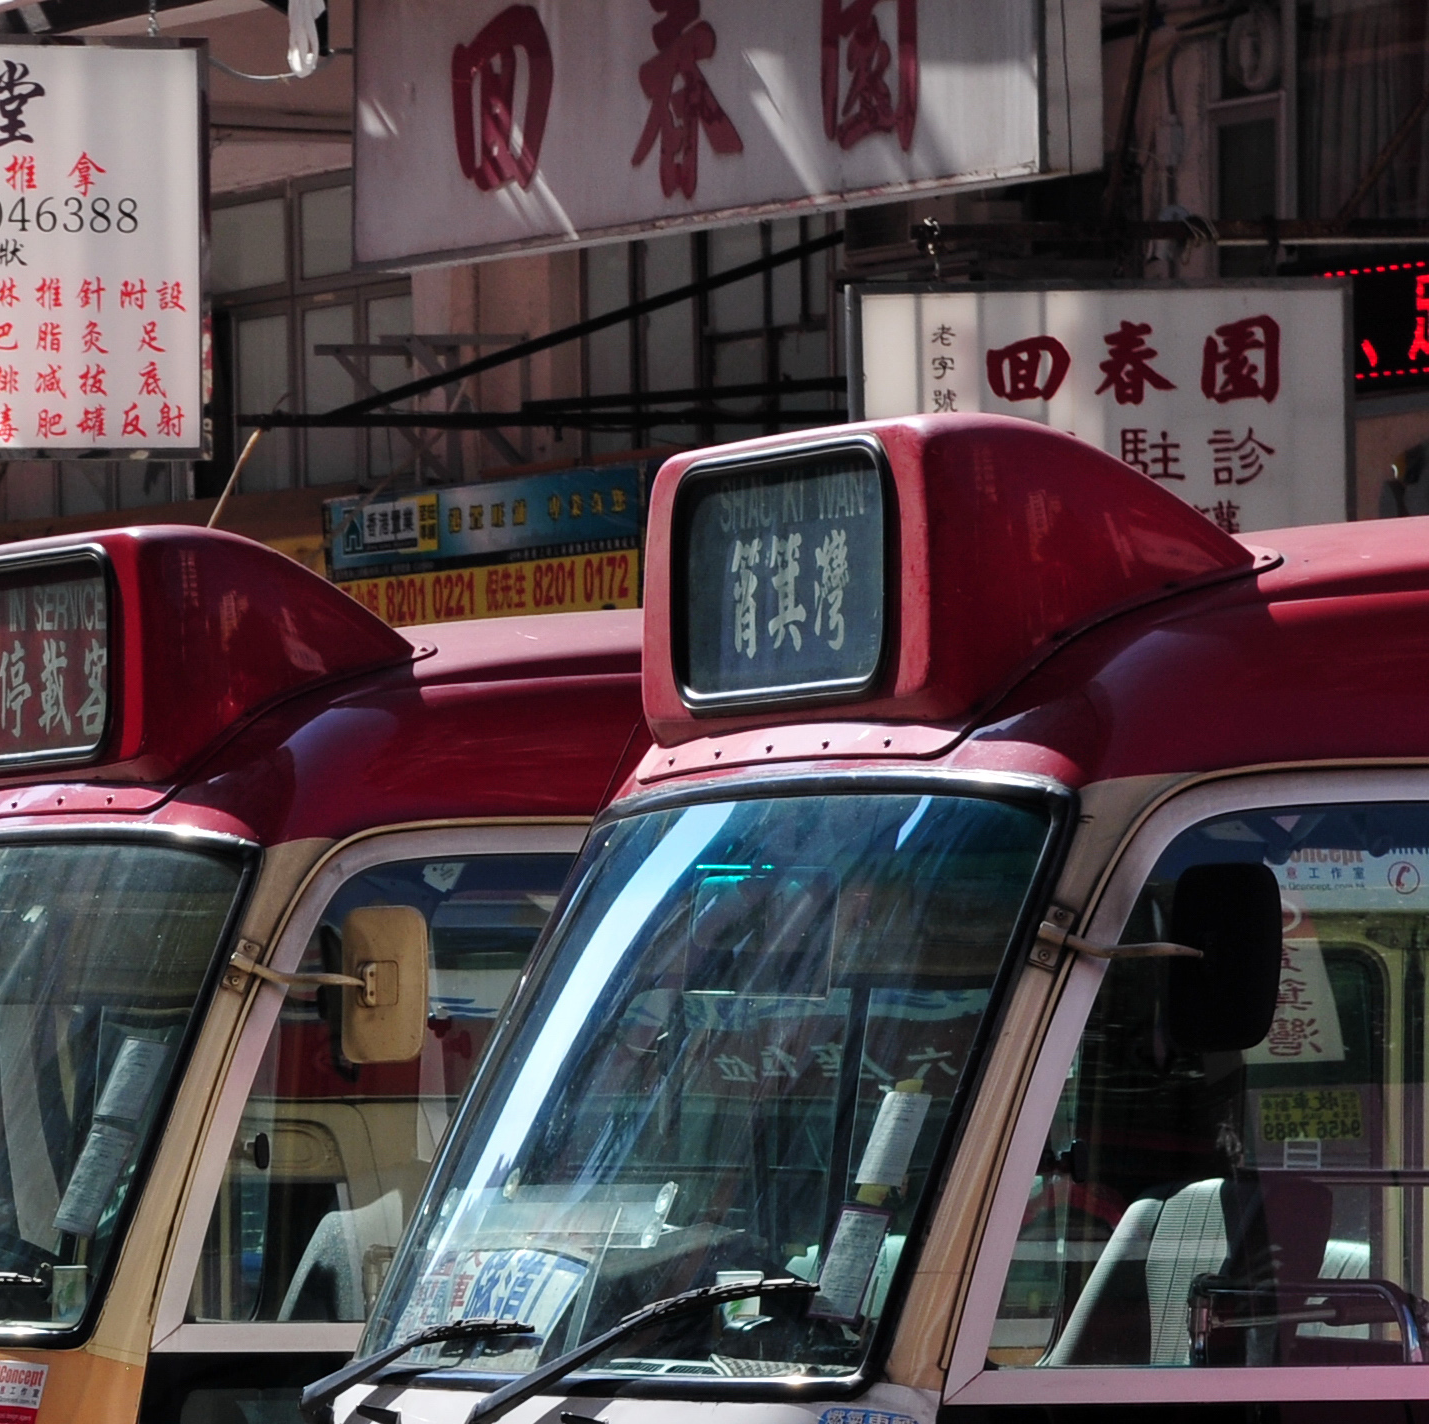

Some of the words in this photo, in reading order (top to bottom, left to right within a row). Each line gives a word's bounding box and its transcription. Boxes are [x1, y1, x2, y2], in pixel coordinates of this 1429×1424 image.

[75, 277, 109, 440] 針灸拔罐
[782, 468, 804, 524] KI
[815, 462, 865, 521] WAN
[9, 588, 27, 631] IN
[33, 583, 107, 632] SERVICE
[385, 577, 426, 622] 8201
[432, 571, 475, 619] 0221
[532, 560, 576, 608] 8201
[583, 554, 629, 603] 0172
